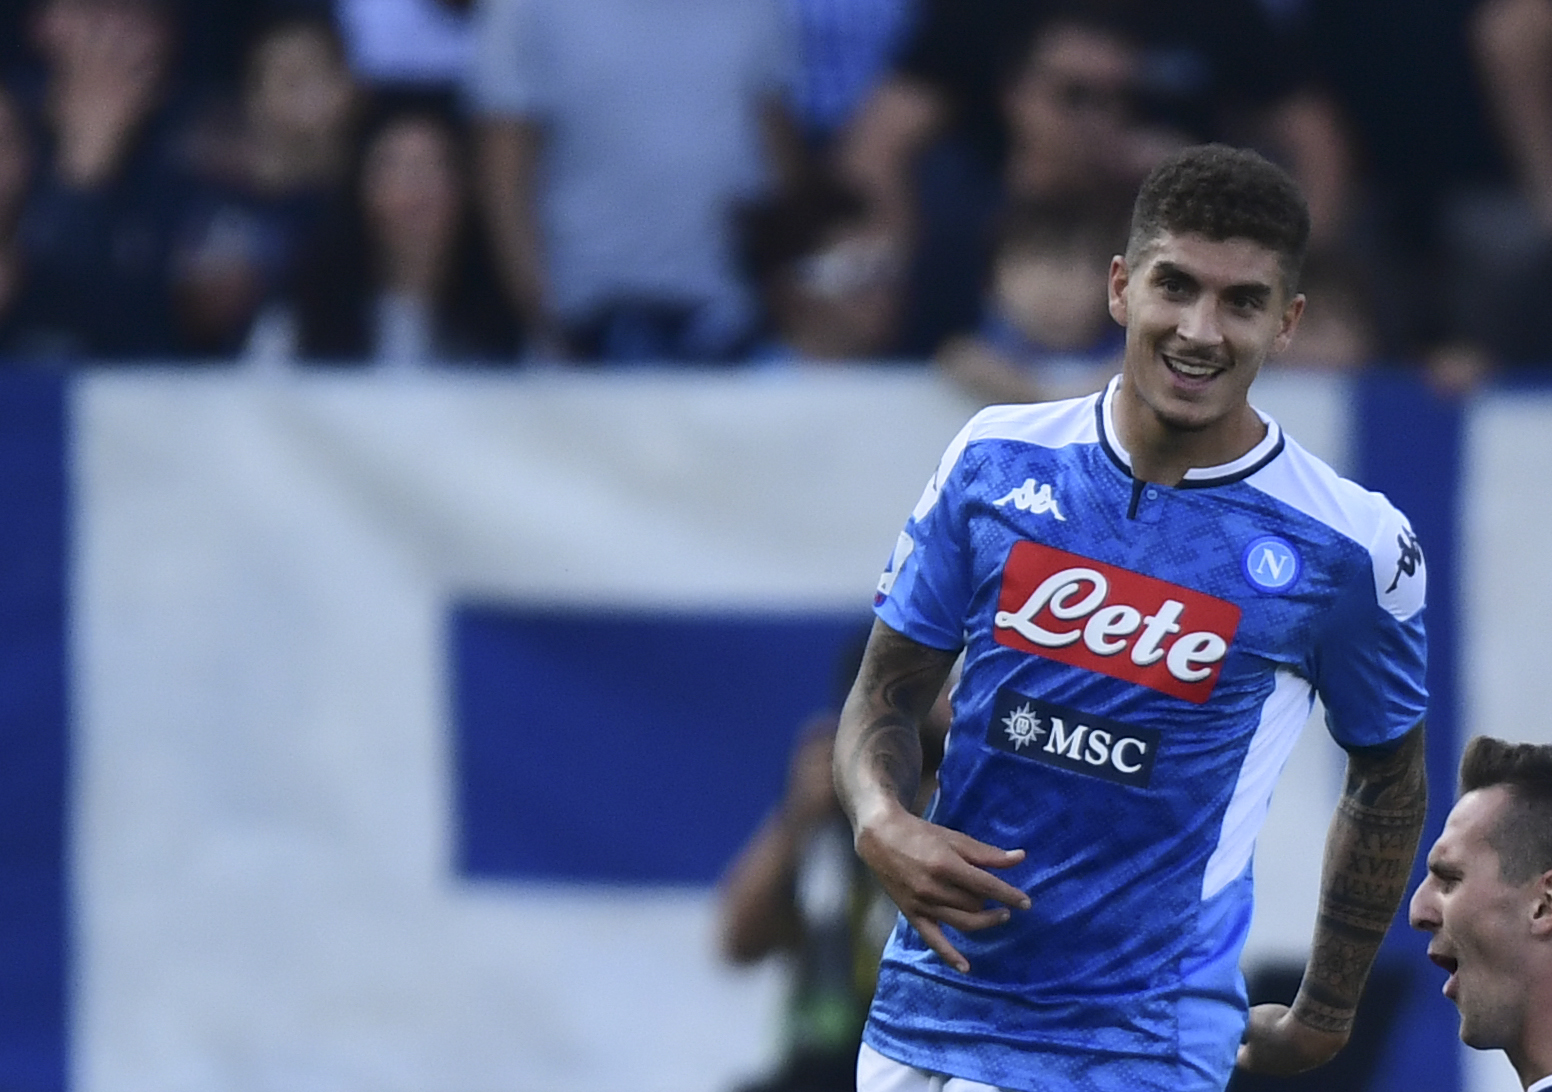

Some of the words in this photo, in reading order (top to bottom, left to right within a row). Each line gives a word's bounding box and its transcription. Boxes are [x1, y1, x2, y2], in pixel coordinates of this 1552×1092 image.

[1256, 548, 1288, 580] N
[995, 567, 1227, 683] Lete
[1043, 717, 1147, 773] MSC
